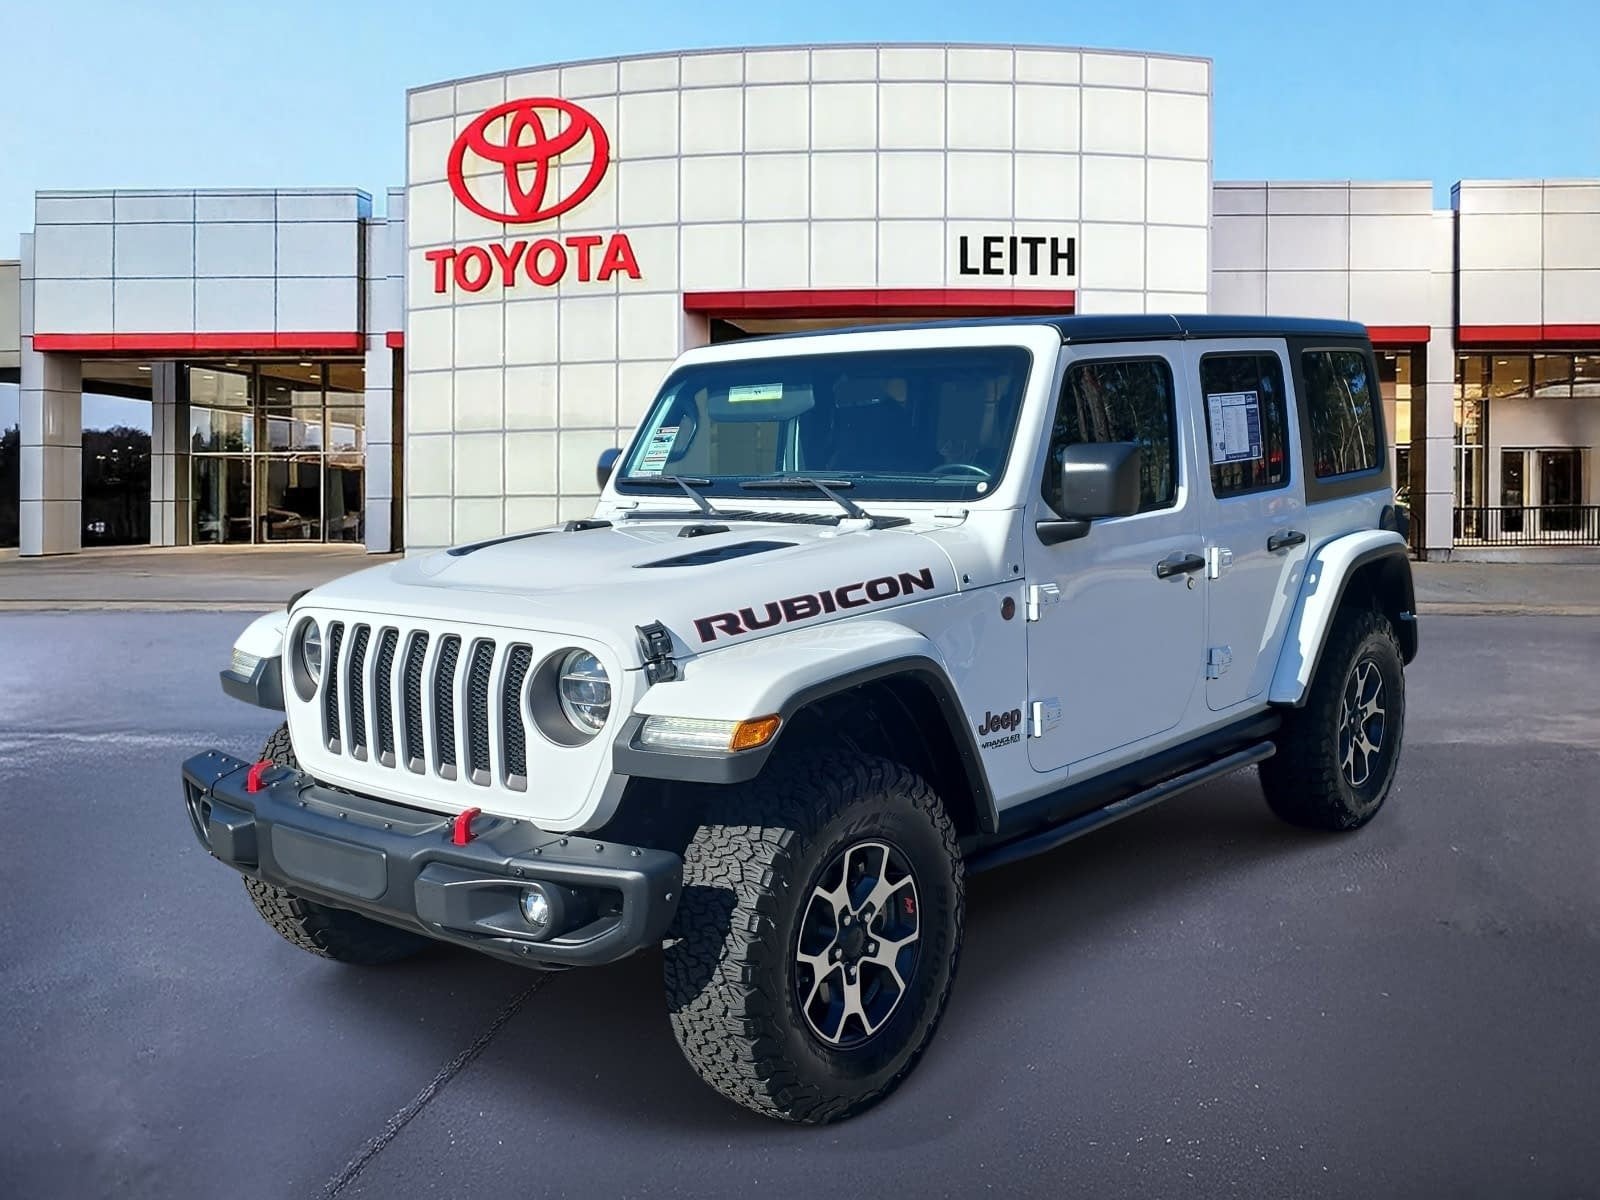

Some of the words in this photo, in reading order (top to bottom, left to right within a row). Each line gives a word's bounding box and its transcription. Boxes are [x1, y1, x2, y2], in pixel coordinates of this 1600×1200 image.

[425, 233, 642, 293] TOYOTA
[960, 236, 1075, 276] LEITH
[693, 567, 935, 644] RUBICON
[978, 708, 1021, 736] Jeep
